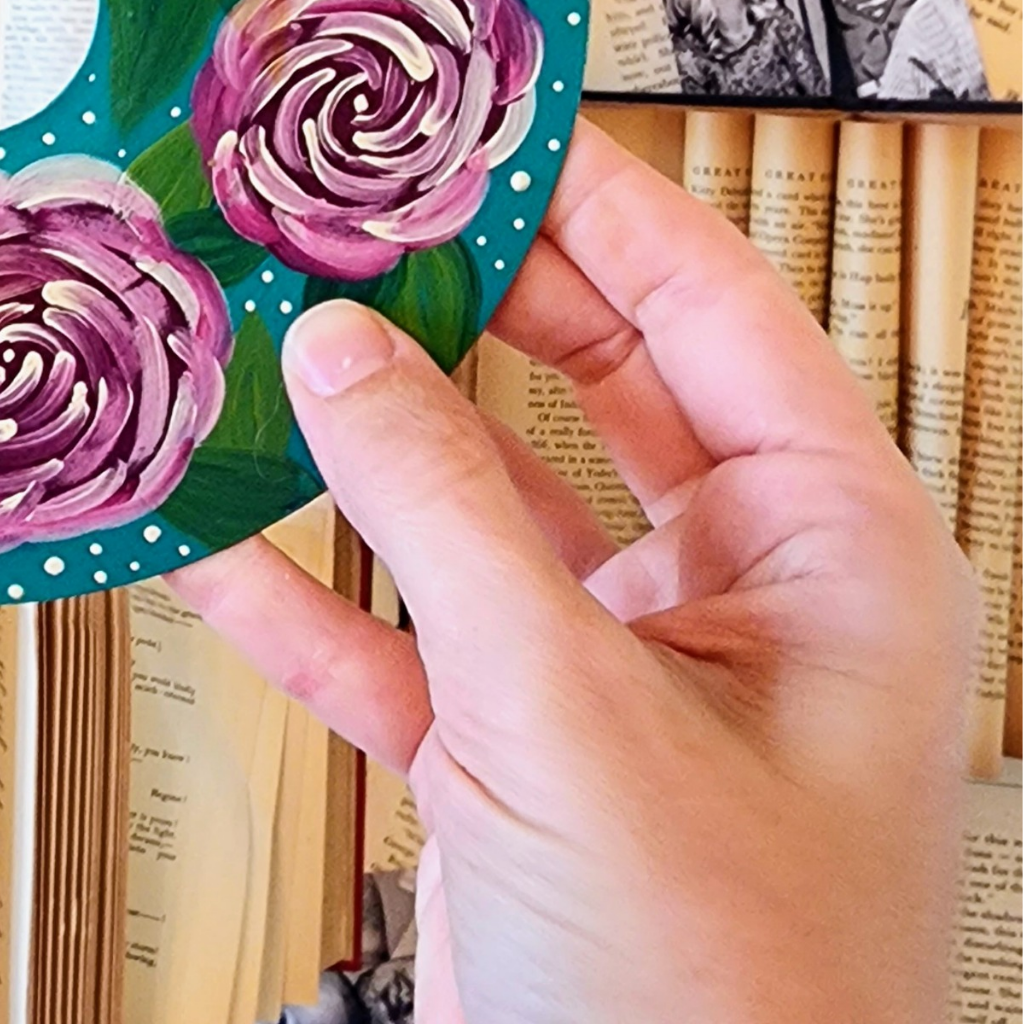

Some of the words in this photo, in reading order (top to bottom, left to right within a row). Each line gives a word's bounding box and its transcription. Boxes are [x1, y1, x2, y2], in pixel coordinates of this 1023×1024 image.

[692, 166, 742, 178] GREAT
[765, 169, 816, 182] GREAT
[846, 178, 898, 190] GREAT
[537, 412, 551, 423] Of
